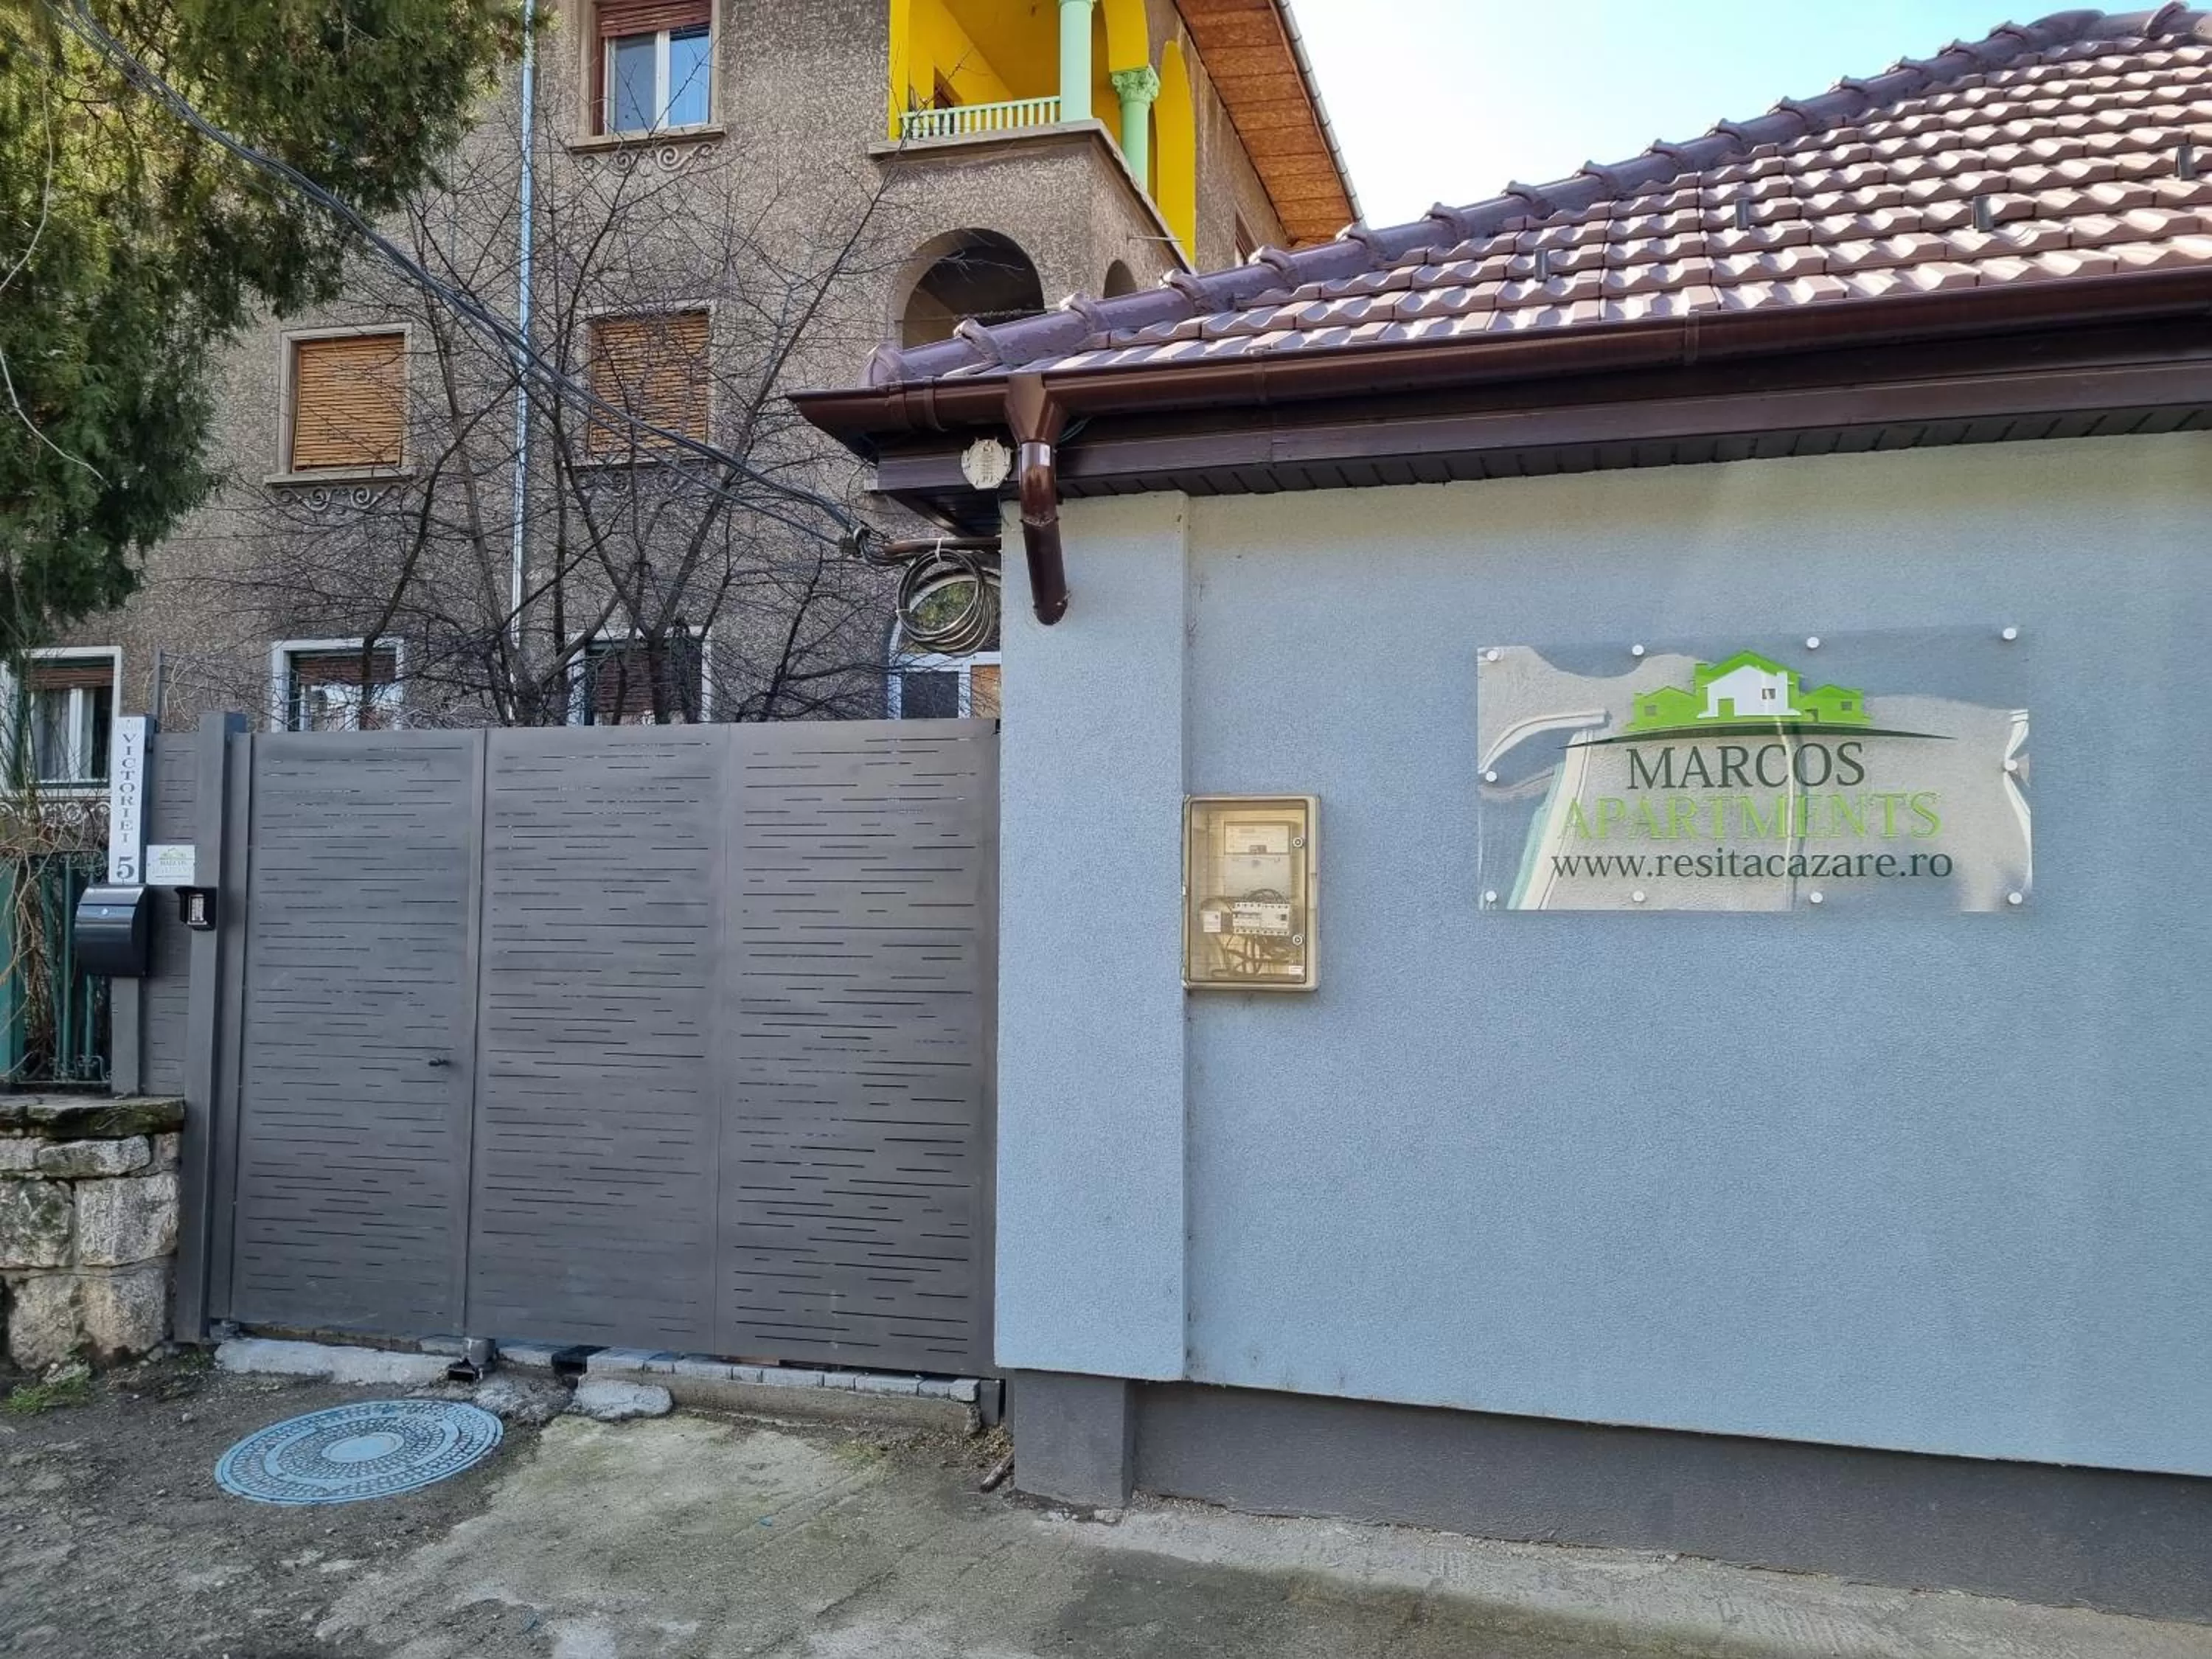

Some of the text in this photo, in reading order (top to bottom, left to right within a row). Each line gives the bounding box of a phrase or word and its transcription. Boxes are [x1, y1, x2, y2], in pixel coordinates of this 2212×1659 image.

[119, 733, 137, 843] VICTORIEI
[1626, 742, 1865, 790] MARCOS
[1557, 792, 1944, 840] APARTMENTS
[116, 856, 134, 880] 5
[1551, 847, 1953, 878] www.resitacazare.ro
